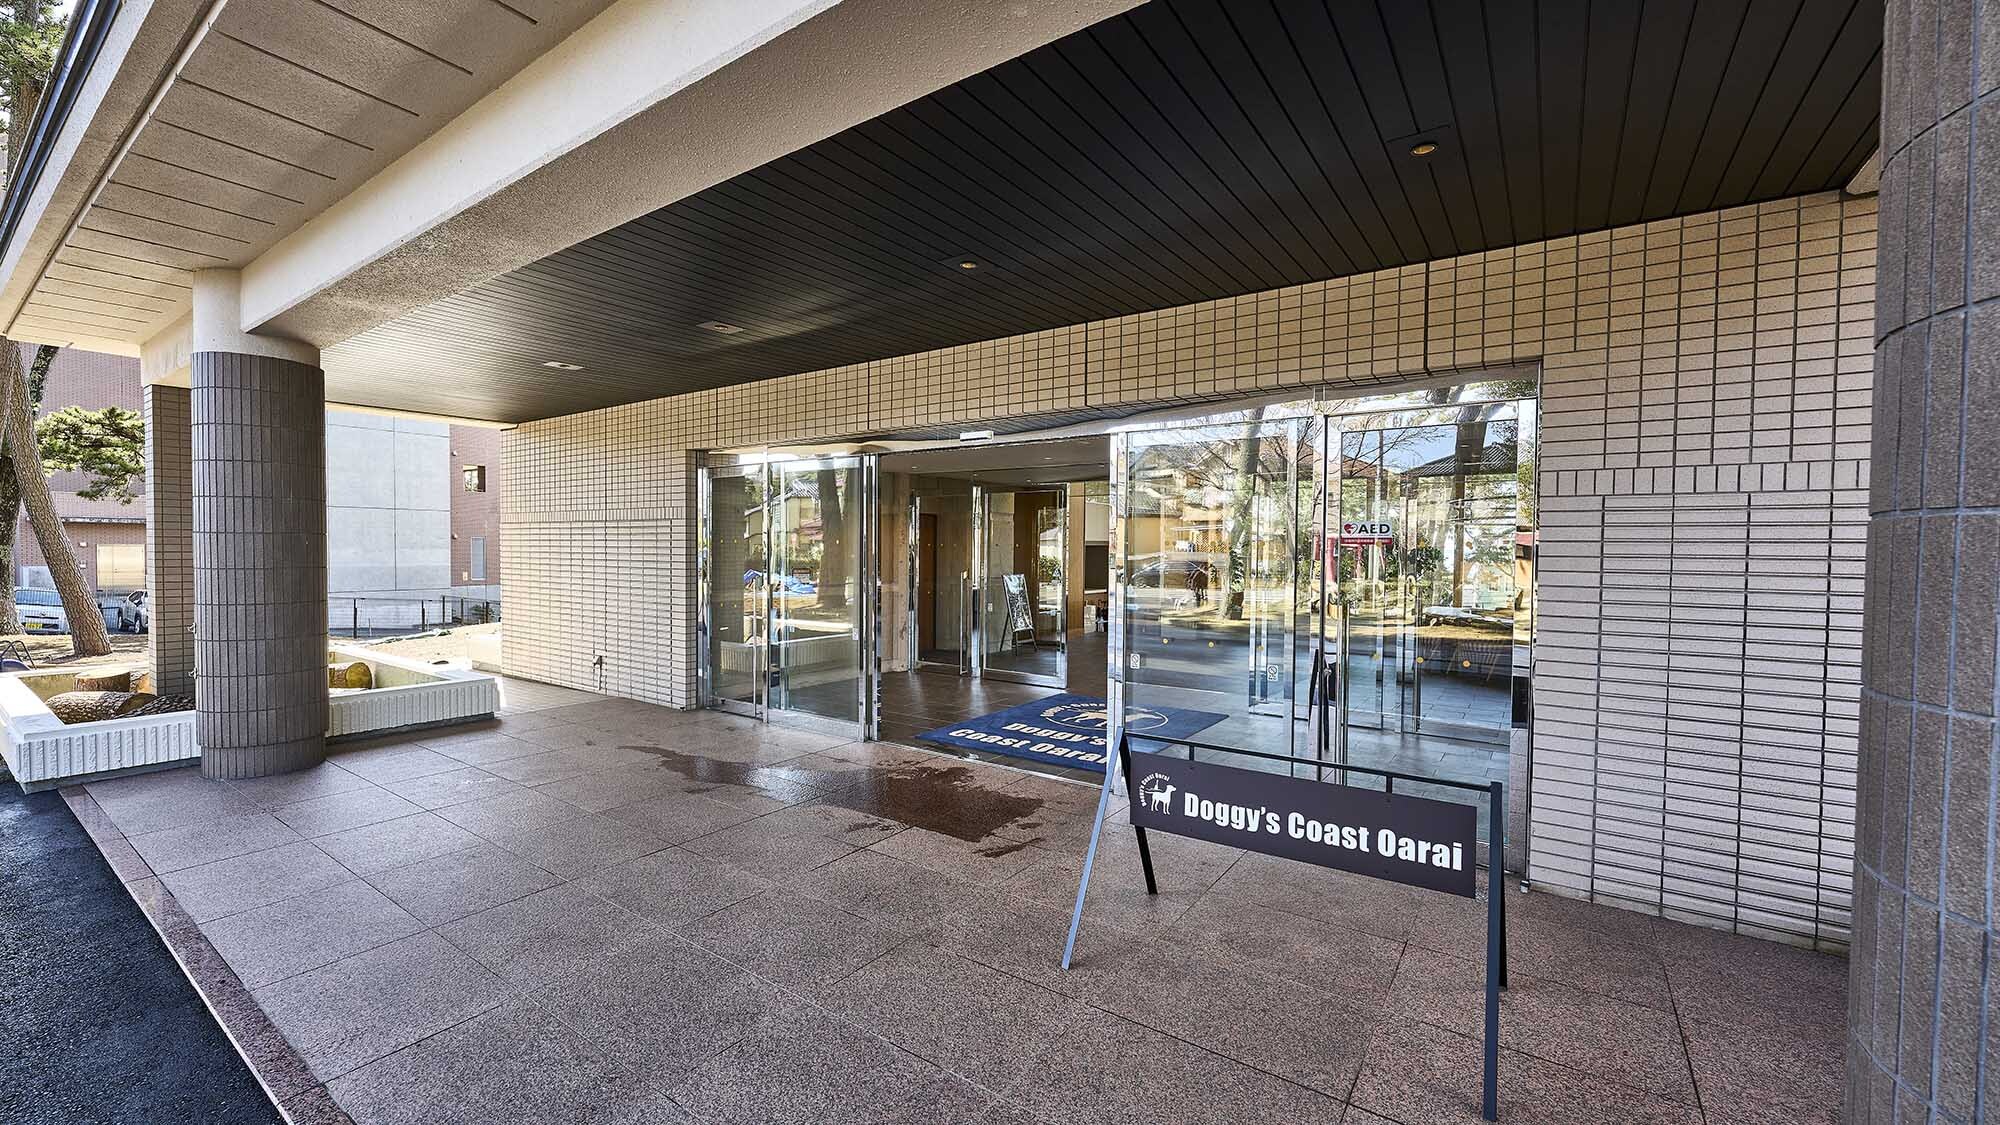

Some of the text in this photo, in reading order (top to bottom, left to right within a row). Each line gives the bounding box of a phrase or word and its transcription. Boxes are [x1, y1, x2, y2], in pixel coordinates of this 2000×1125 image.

[1358, 524, 1390, 534] AED
[948, 729, 1031, 748] Coast
[1184, 792, 1463, 871] Doggy's Coast Oarai
